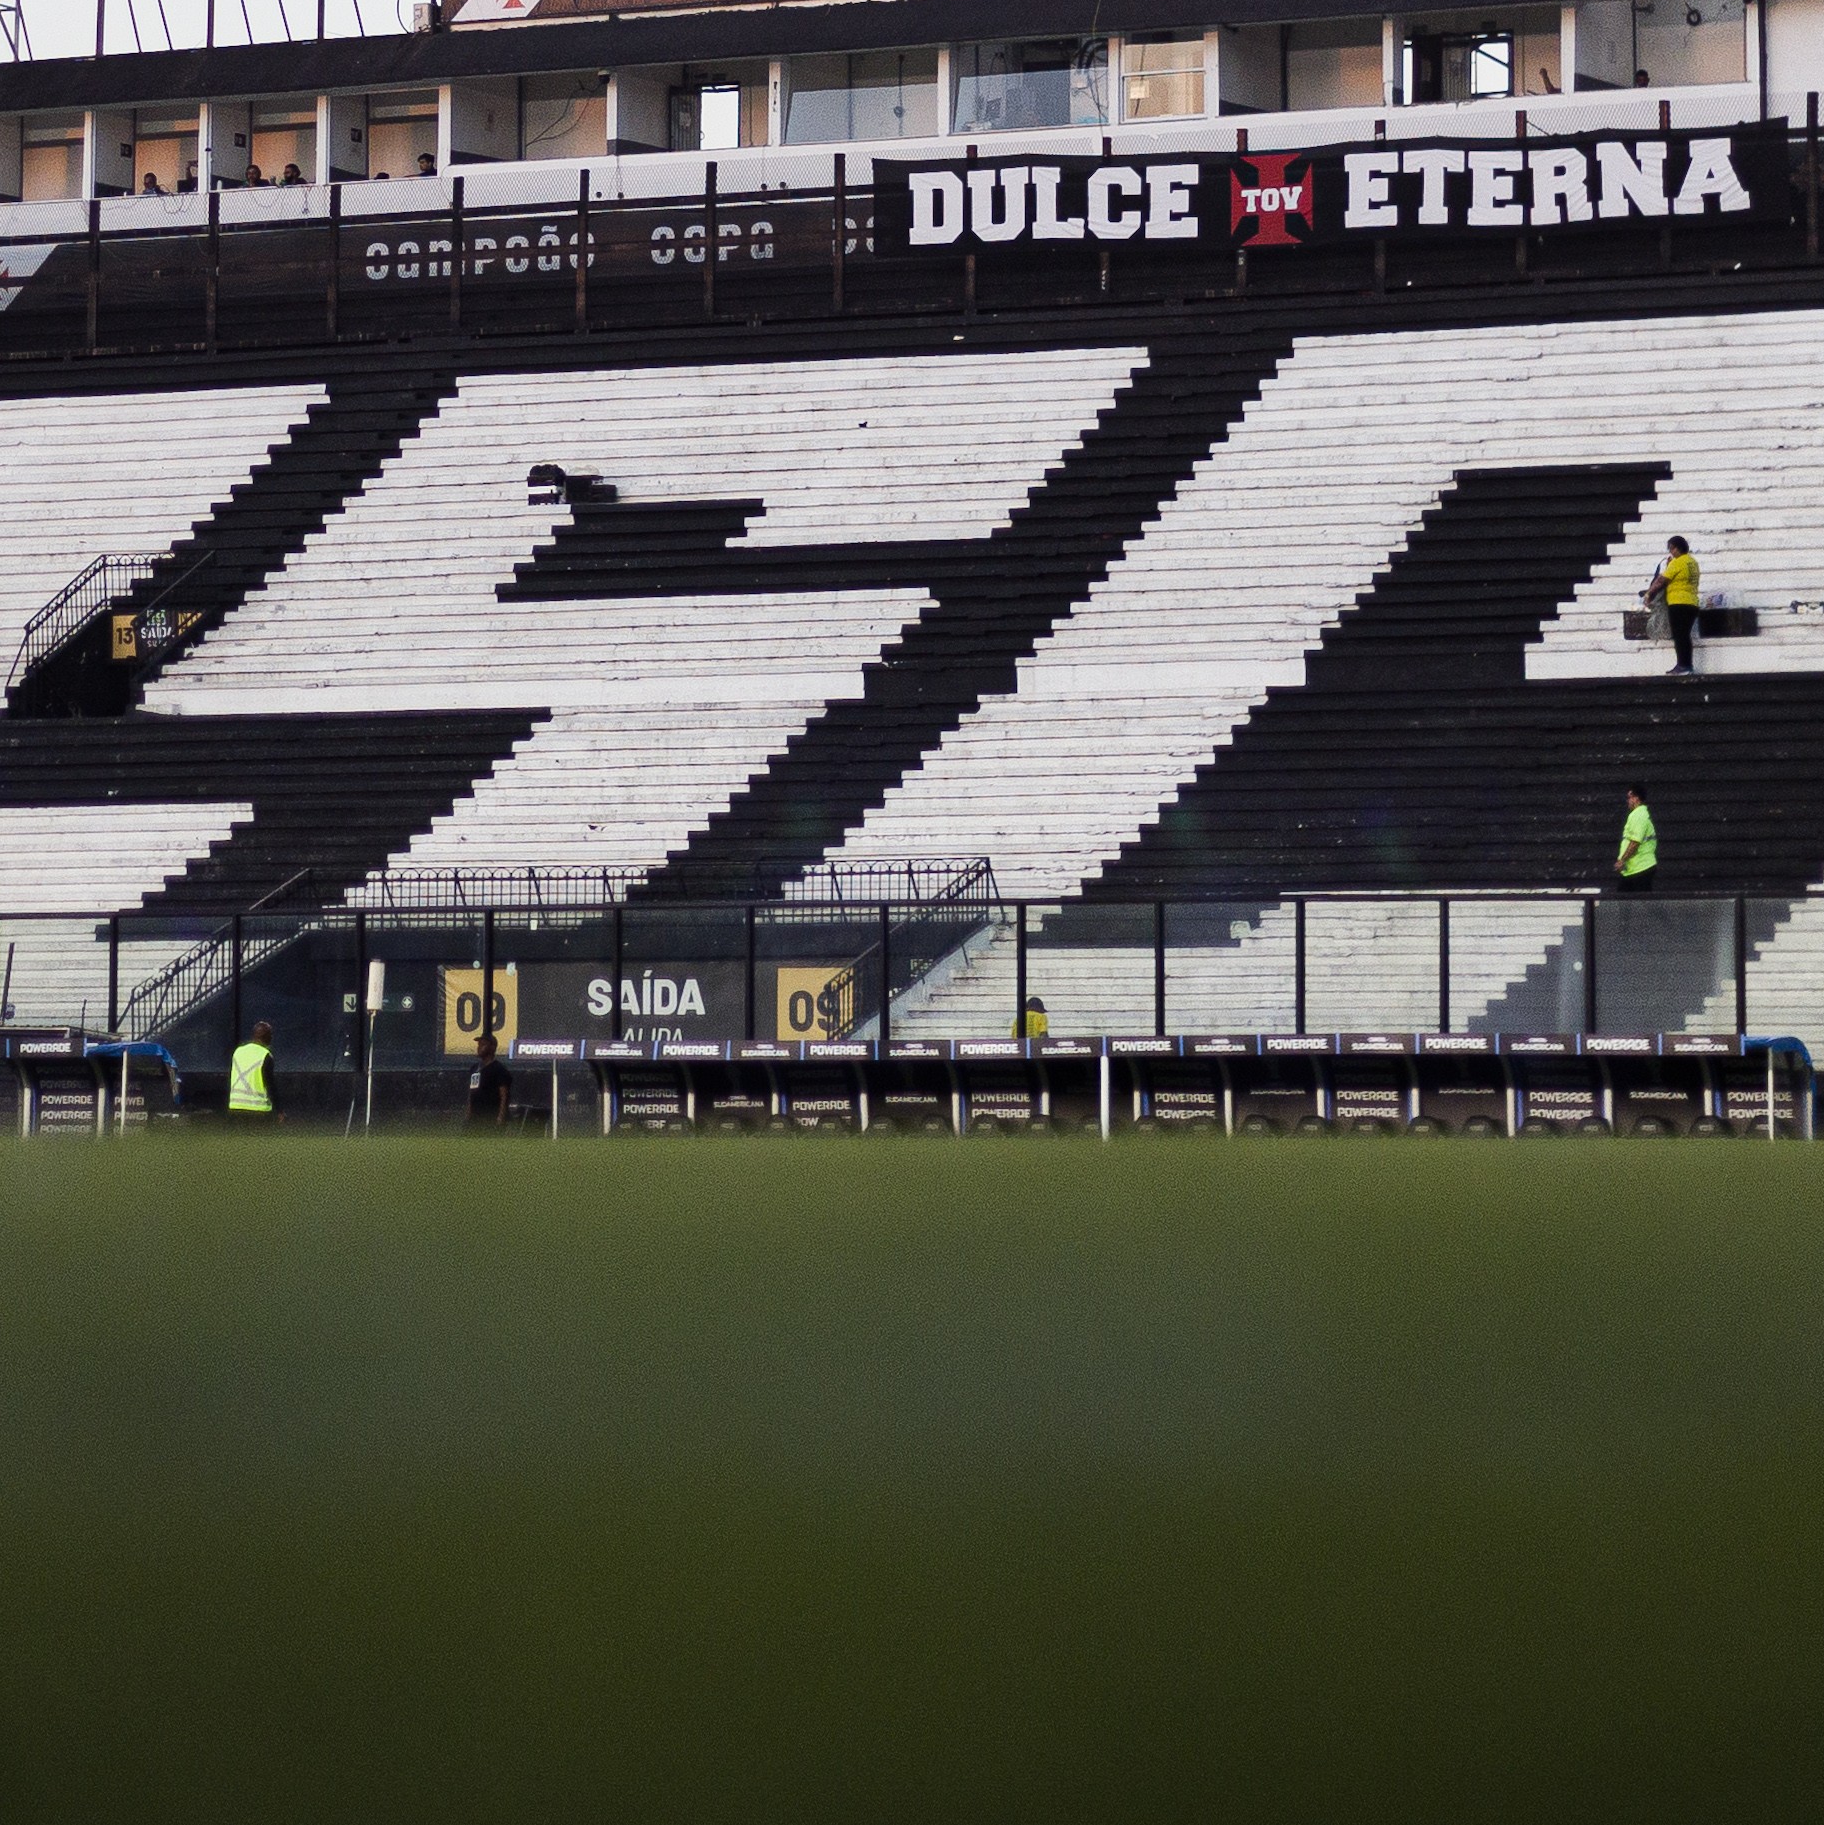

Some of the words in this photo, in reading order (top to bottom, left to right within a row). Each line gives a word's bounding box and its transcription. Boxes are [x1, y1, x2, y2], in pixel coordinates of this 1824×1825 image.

[908, 165, 1199, 245] DULCE
[1240, 186, 1304, 215] TOV
[1343, 138, 1752, 228] ETERNA
[116, 628, 133, 644] 13
[587, 969, 706, 1016] SAÍDA
[20, 1043, 71, 1053] POWERADE
[518, 1044, 573, 1054] POWERADE
[960, 1043, 1019, 1054] POWERADE
[1112, 1040, 1172, 1051] POWERADE
[1267, 1039, 1328, 1050] POWERADE
[1425, 1038, 1487, 1050] POWERADE
[1587, 1038, 1650, 1051] POWERADE
[663, 1044, 719, 1056] POWERADE
[810, 1045, 868, 1056] POWERADE
[41, 1095, 93, 1104] POWERADE
[1155, 1092, 1215, 1103] POWERADE
[1337, 1090, 1399, 1101] POWERADE
[1530, 1091, 1593, 1103] POWERADE
[623, 1103, 679, 1114] POWERADE
[792, 1100, 851, 1111] POWERADE
[41, 1111, 93, 1120] POWERADE
